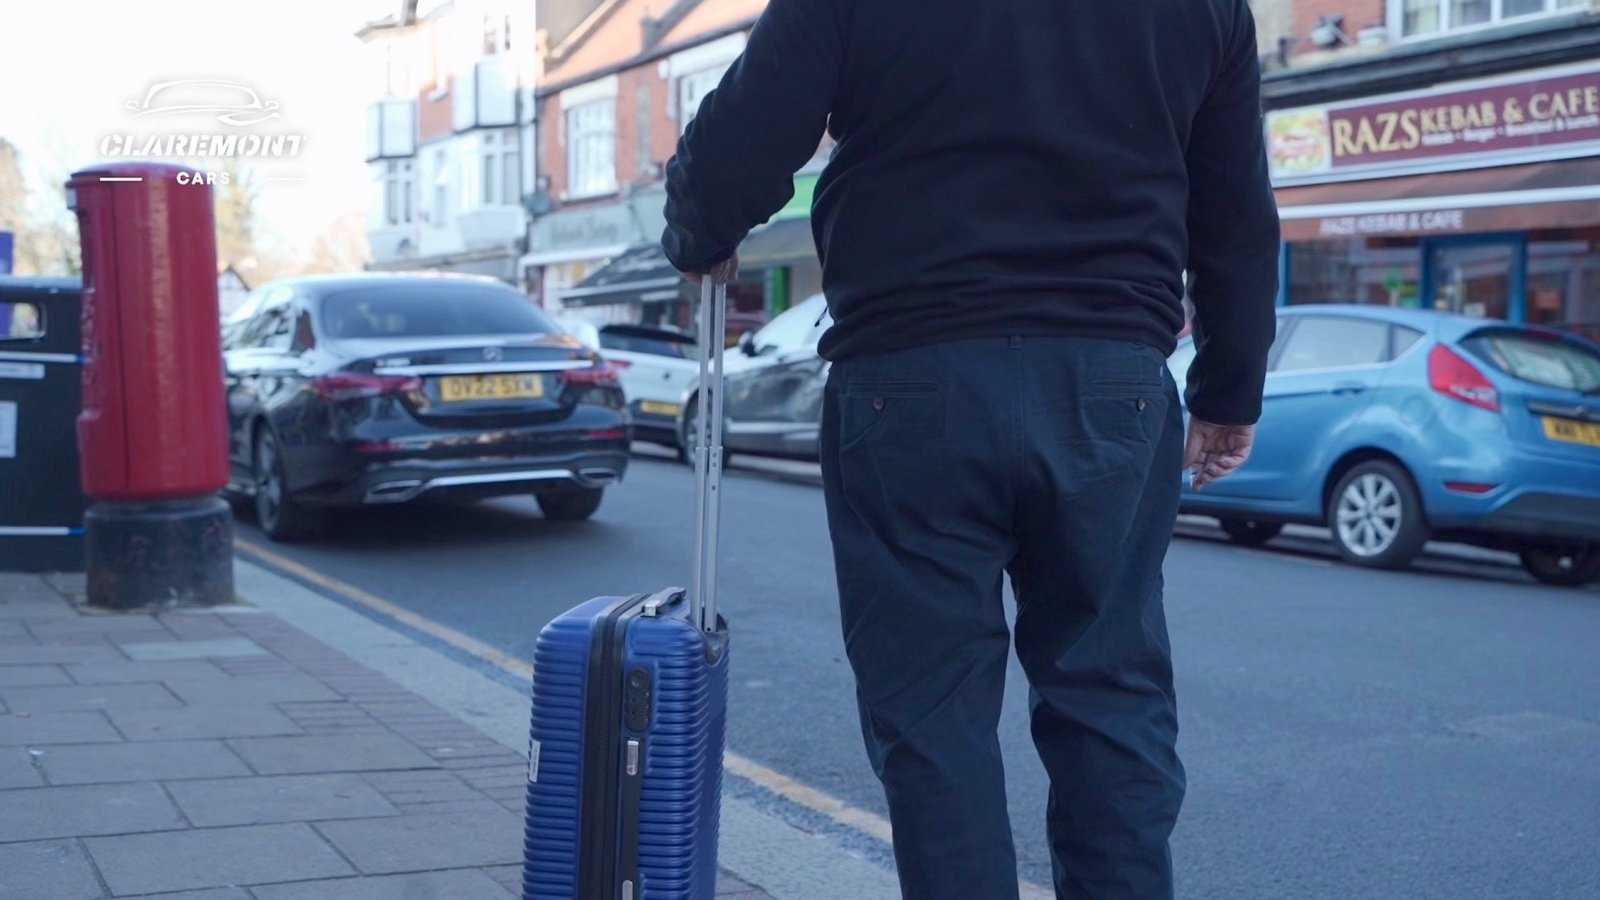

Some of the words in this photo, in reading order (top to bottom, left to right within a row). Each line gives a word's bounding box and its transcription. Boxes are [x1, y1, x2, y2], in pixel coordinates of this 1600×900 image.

[1331, 109, 1420, 157] RAZS
[1420, 101, 1497, 133] KEBAB
[1502, 97, 1524, 124] &
[1528, 86, 1599, 120] CAFE
